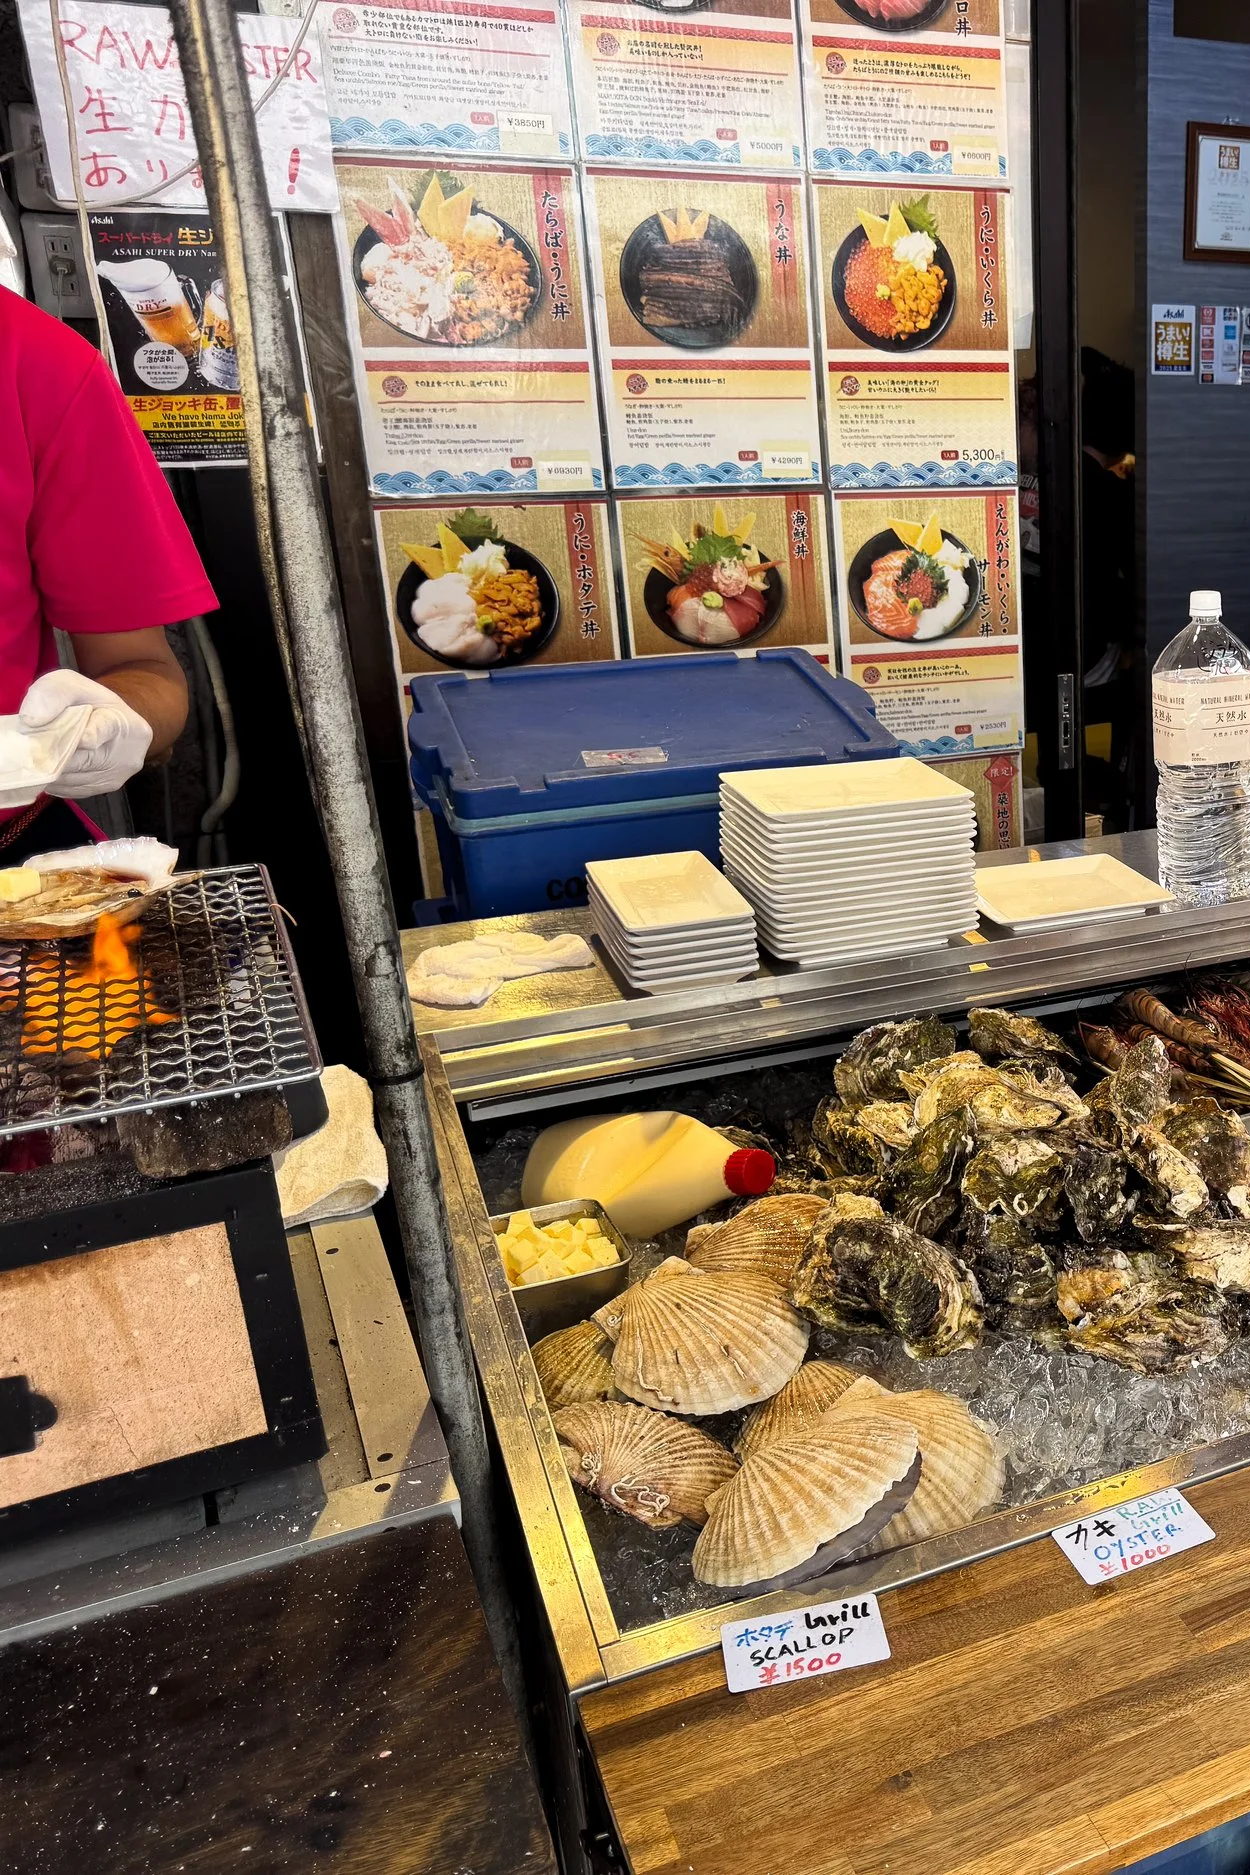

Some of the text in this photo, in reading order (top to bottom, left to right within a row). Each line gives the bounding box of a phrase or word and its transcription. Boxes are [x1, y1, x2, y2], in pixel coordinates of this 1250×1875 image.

[91, 216, 114, 225] Asahi
[774, 199, 792, 266] うな丼
[98, 231, 173, 246] スーパードライ
[112, 248, 199, 257] ASAHI SUPER DRY
[980, 206, 998, 329] うに・いくら丼
[1163, 308, 1185, 319] Asahi
[1157, 325, 1190, 341] うまい!
[1157, 341, 1190, 361] 樽生
[162, 413, 177, 421] We
[180, 412, 200, 421] have
[201, 412, 226, 421] Nama
[772, 457, 803, 465] ¥4290円
[791, 510, 809, 559] 海鮮丼
[573, 512, 601, 639] うに・ホタテ丼
[977, 559, 993, 638] サーモン丼
[1201, 696, 1222, 705] NATURAL
[1216, 710, 1247, 724] 天然水
[1065, 1520, 1116, 1551] カキ
[1094, 1523, 1182, 1560] OYSTER
[1098, 1544, 1171, 1576] ¥1000
[750, 1627, 855, 1667] SCALLOP
[758, 1652, 843, 1685] ¥1500
